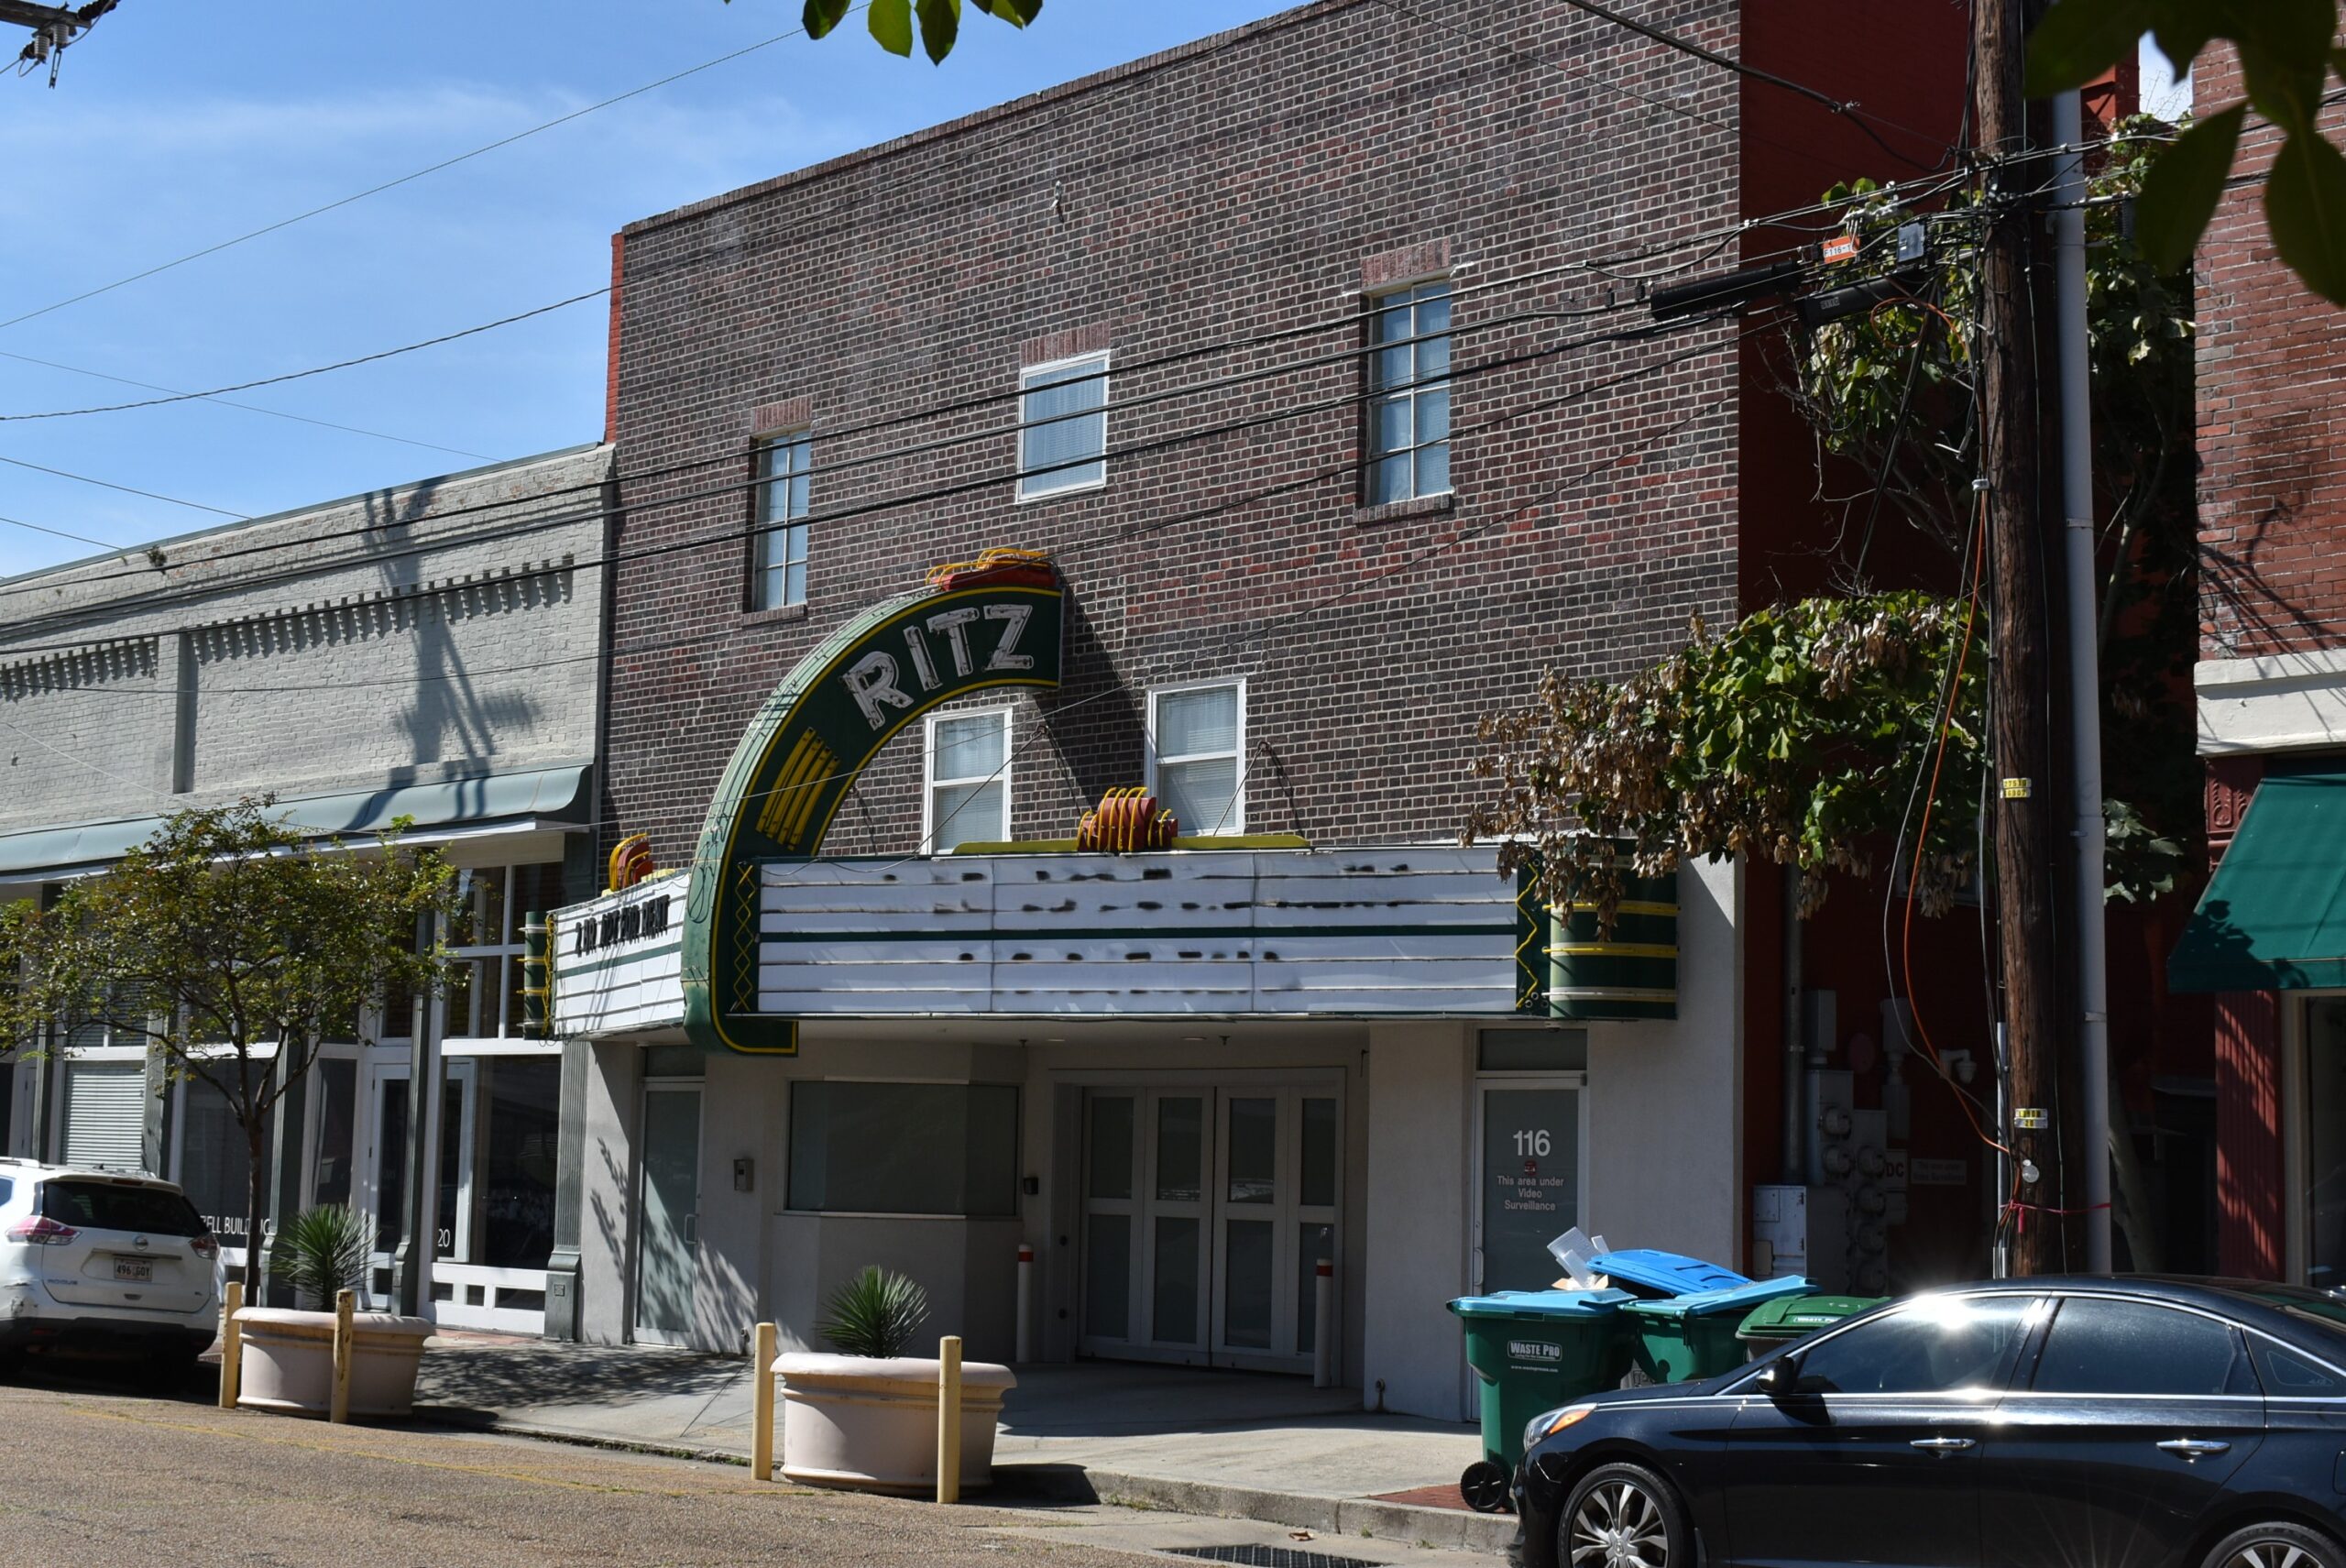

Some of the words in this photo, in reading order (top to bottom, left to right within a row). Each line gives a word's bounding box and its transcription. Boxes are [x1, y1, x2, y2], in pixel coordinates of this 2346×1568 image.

[839, 603, 1035, 730] RITZ
[641, 894, 670, 938] RENT
[1513, 1129, 1551, 1157] 116
[1496, 1175, 1515, 1186] This
[1518, 1177, 1537, 1186] area
[1540, 1176, 1565, 1187] under
[1518, 1188, 1542, 1199] Video
[1504, 1200, 1556, 1212] Surveillance
[117, 1265, 132, 1275] 496
[1510, 1342, 1540, 1355] WASTE
[1542, 1344, 1561, 1357] PRO
